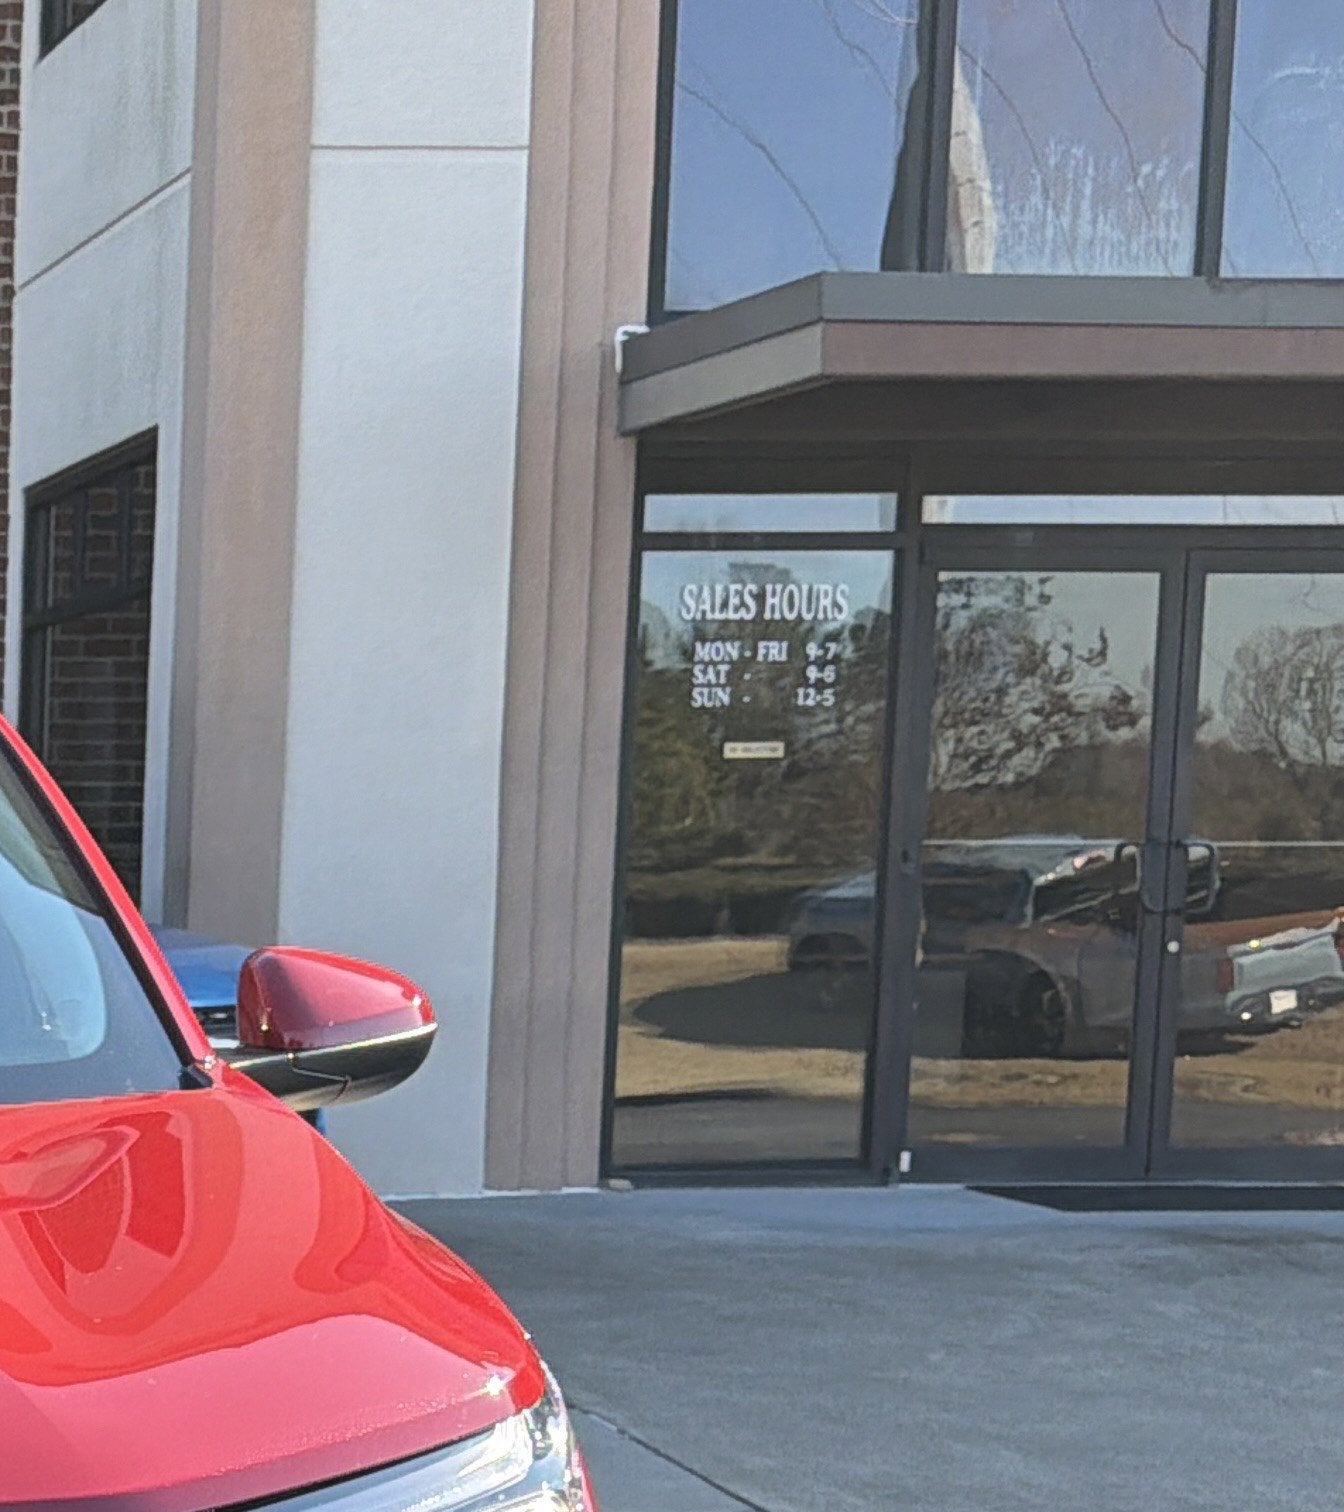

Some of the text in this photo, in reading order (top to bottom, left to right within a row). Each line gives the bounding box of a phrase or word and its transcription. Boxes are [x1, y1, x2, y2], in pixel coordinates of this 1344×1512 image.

[681, 582, 849, 621] SALES HOURS
[693, 640, 741, 662] MON
[756, 640, 789, 662] FRI
[692, 664, 732, 684] SAT
[691, 686, 732, 708] SUN
